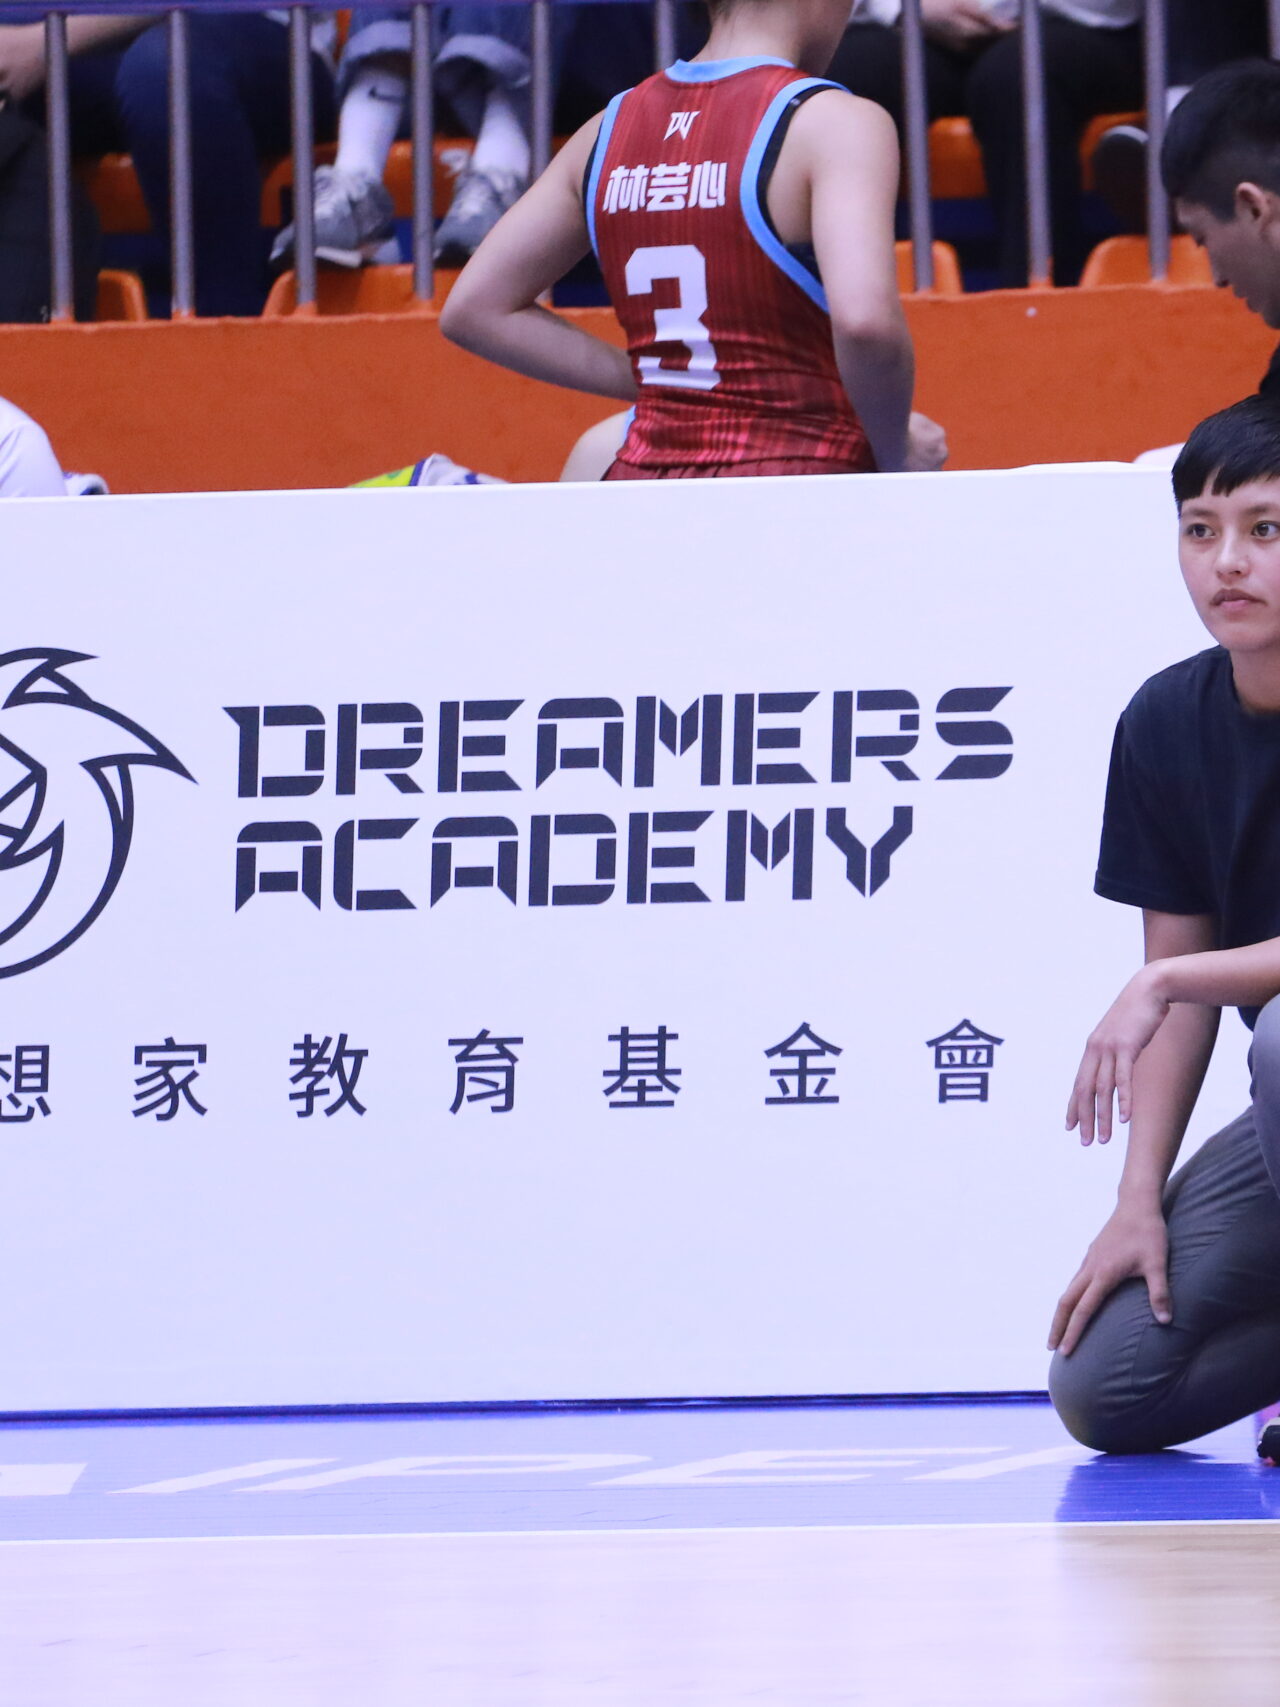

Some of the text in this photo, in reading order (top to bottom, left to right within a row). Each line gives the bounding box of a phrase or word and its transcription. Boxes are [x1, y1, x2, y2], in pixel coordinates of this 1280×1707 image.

[603, 161, 727, 214] 林芸心
[625, 245, 721, 391] 3
[222, 686, 1014, 798] DREAMERS
[235, 806, 913, 913] ACADEMY
[0, 1019, 1004, 1123] 想家教育基金會
